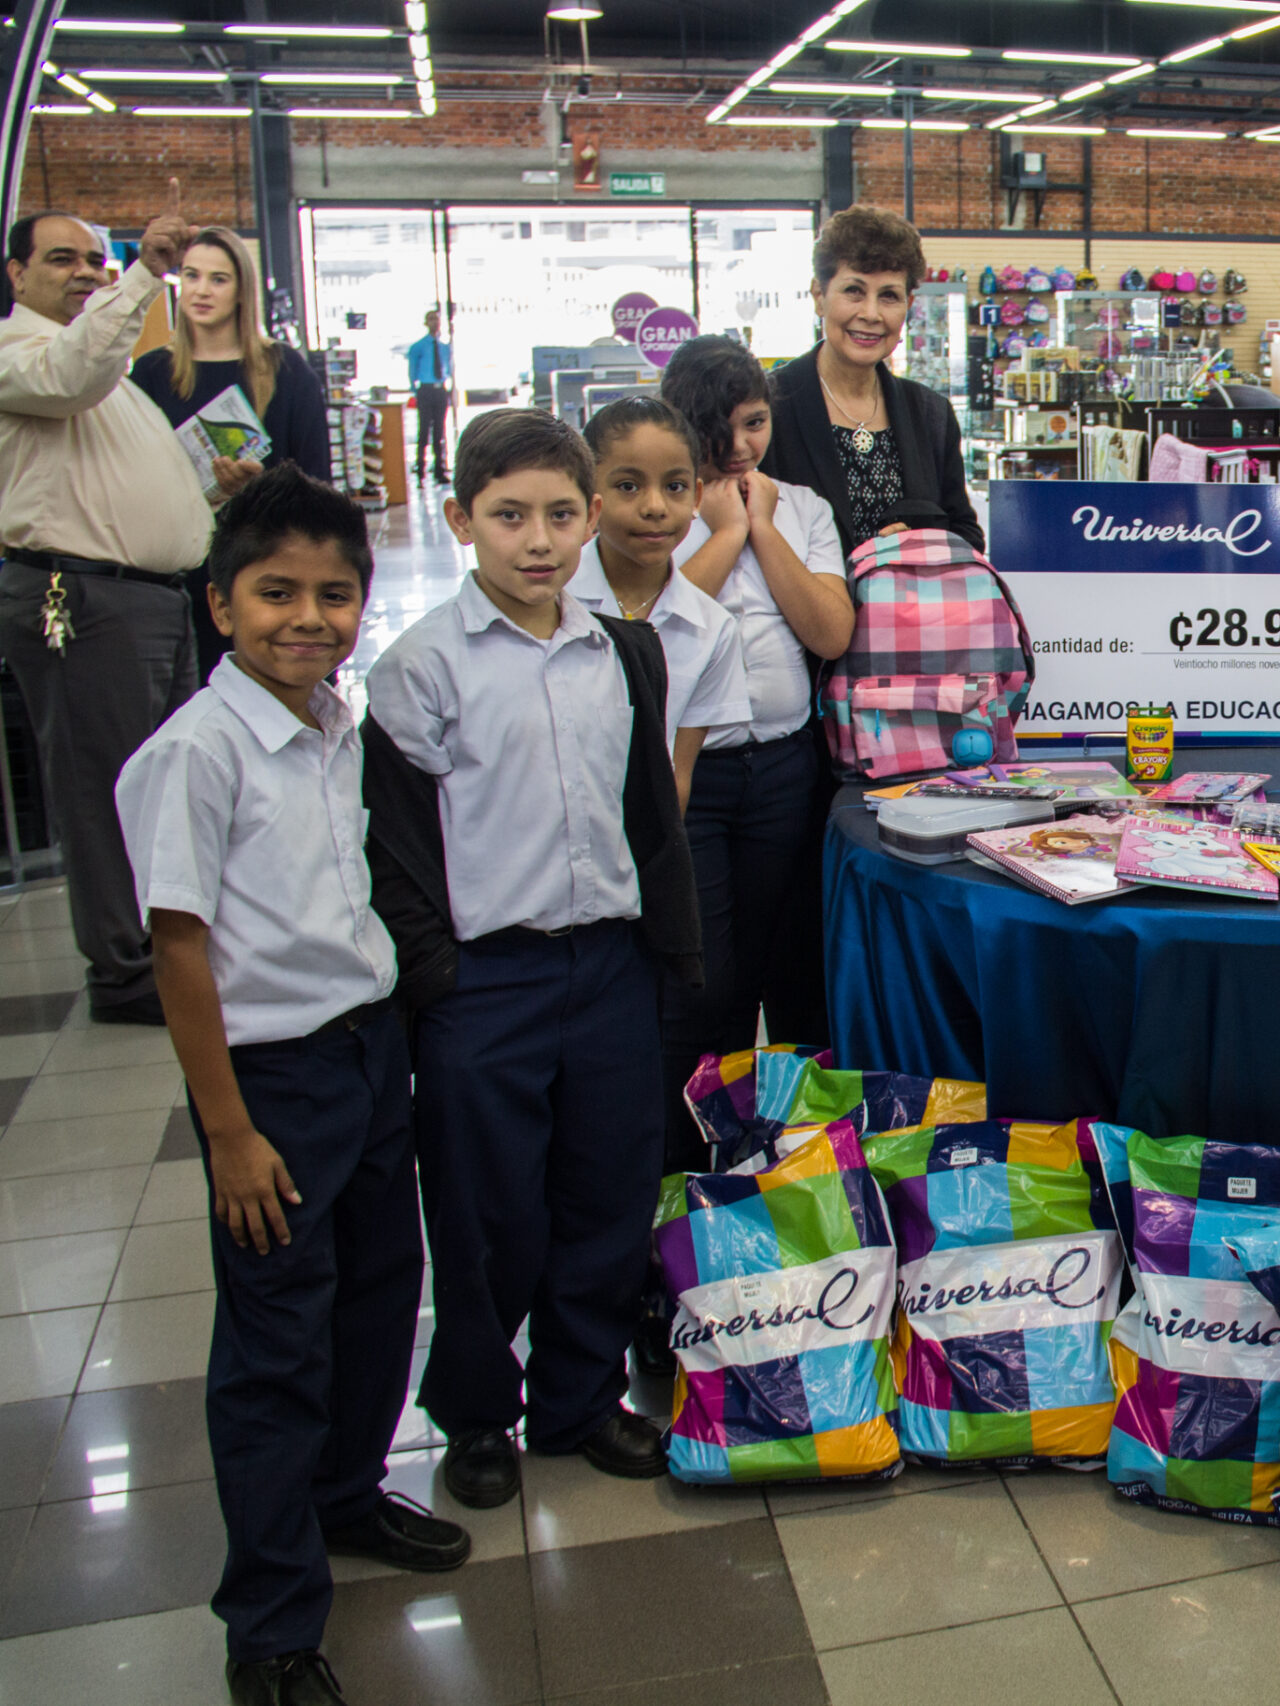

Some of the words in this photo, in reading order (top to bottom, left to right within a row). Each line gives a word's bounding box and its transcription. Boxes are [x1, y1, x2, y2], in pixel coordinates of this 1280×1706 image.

[612, 178, 650, 191] SALIDA
[615, 307, 652, 321] GRA
[987, 308, 997, 323] 1
[356, 315, 367, 328] 2
[642, 327, 692, 342] GRAN
[1072, 505, 1272, 556] Universal
[1032, 637, 1103, 653] cantidad
[1109, 638, 1134, 653] de:
[1173, 658, 1219, 669] Veintiocho
[1220, 658, 1256, 669] millones
[1133, 756, 1167, 765] CRAYONS
[1158, 1498, 1198, 1512] HOGAR
